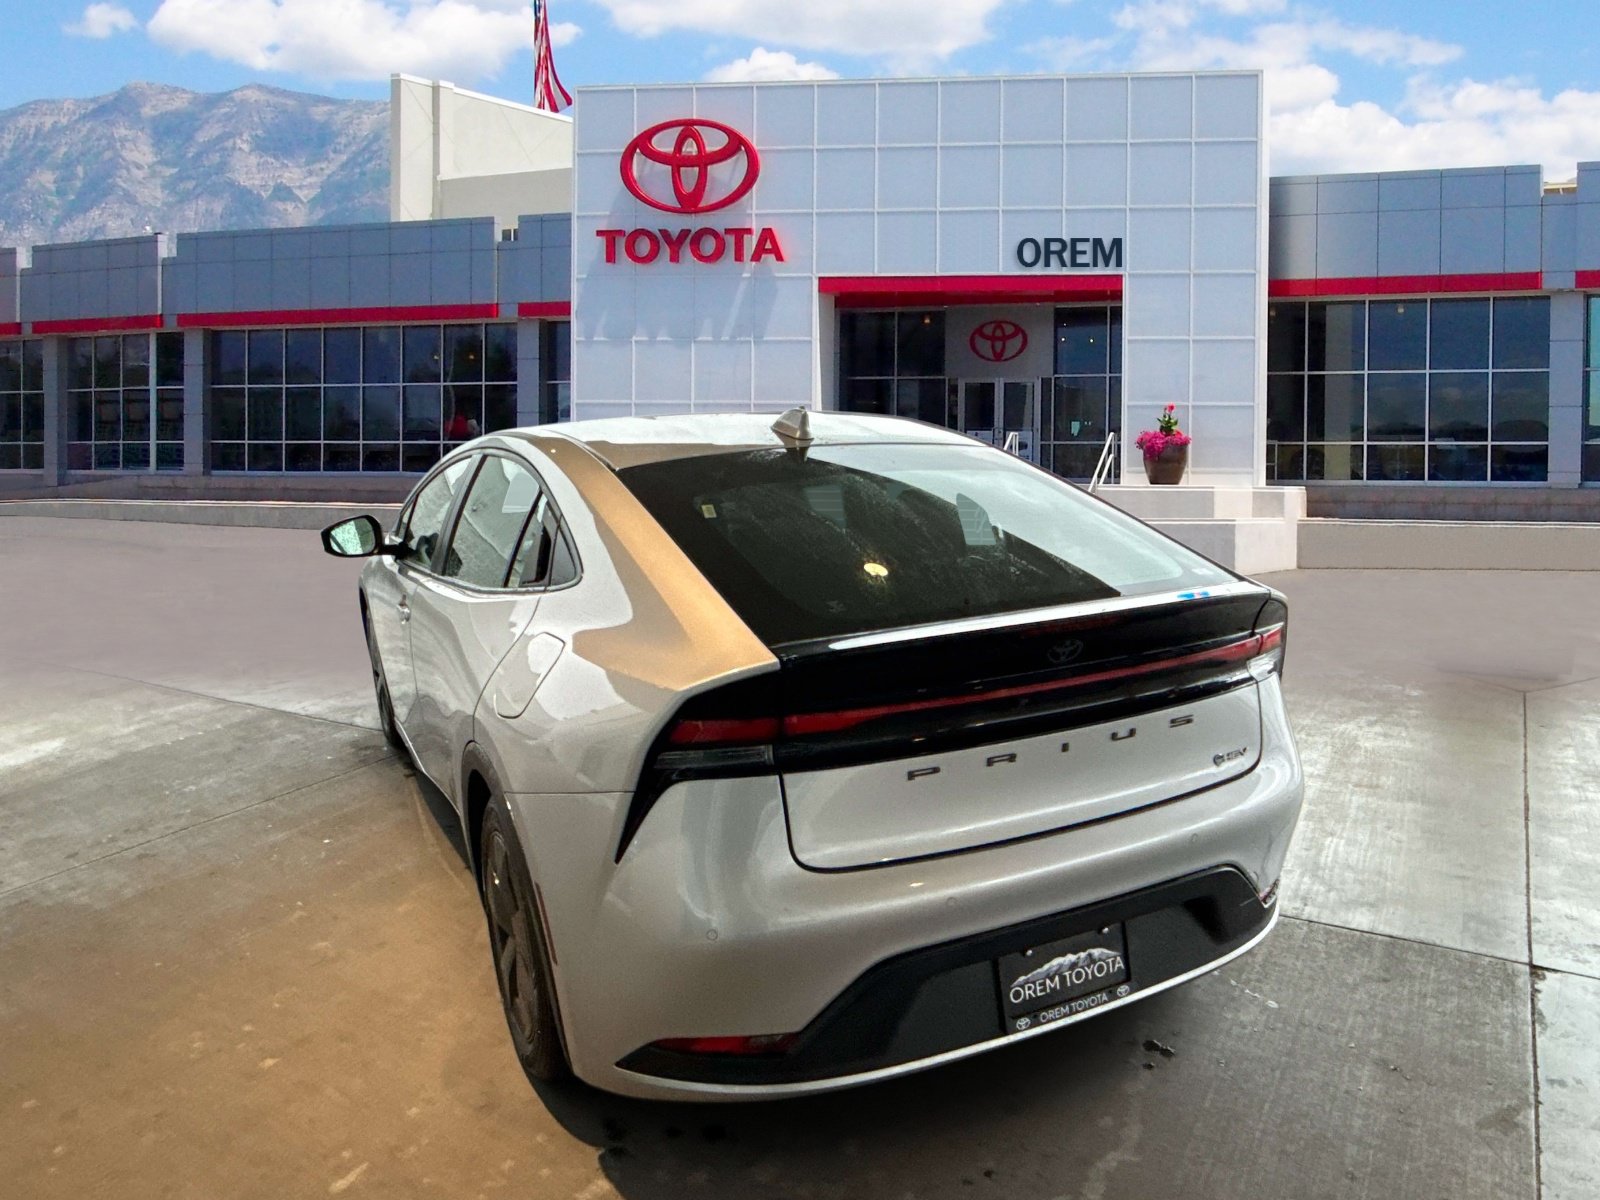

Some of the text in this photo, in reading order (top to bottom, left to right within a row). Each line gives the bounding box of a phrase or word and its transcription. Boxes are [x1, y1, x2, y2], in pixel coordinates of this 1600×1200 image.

[596, 228, 784, 264] TOYOTA
[1017, 237, 1123, 268] OREM
[907, 714, 1194, 781] PRIUS
[1010, 956, 1125, 1003] OREM TOYOTA
[1040, 993, 1108, 1022] OREM TOYOTA
